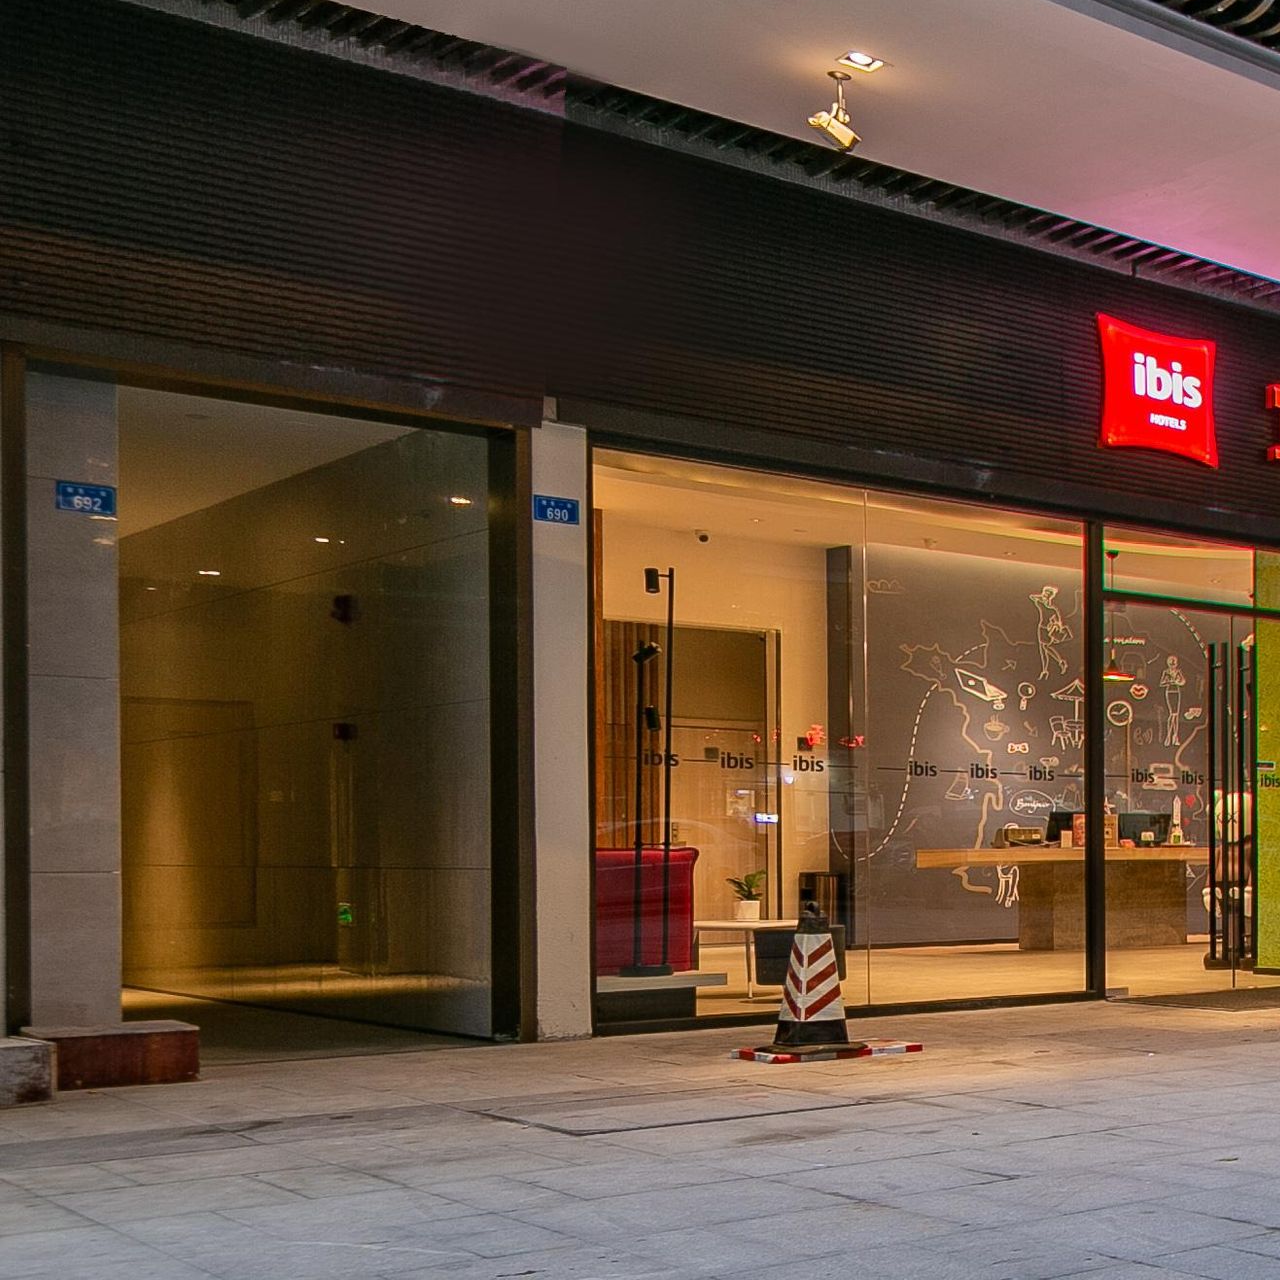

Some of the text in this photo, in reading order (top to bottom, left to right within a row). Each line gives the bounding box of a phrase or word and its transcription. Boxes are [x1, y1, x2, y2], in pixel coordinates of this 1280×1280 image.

[1133, 352, 1202, 408] ibis
[1149, 413, 1187, 431] HOTELS
[73, 495, 102, 511] 692
[546, 507, 569, 521] 690
[721, 752, 754, 769] ibis
[793, 755, 825, 772] ibis
[909, 761, 938, 777] ibis
[970, 763, 998, 779] ibis
[1028, 766, 1055, 781] ibis
[1131, 769, 1155, 784] ibis
[1181, 771, 1205, 785] ibis
[1259, 775, 1280, 787] ibis
